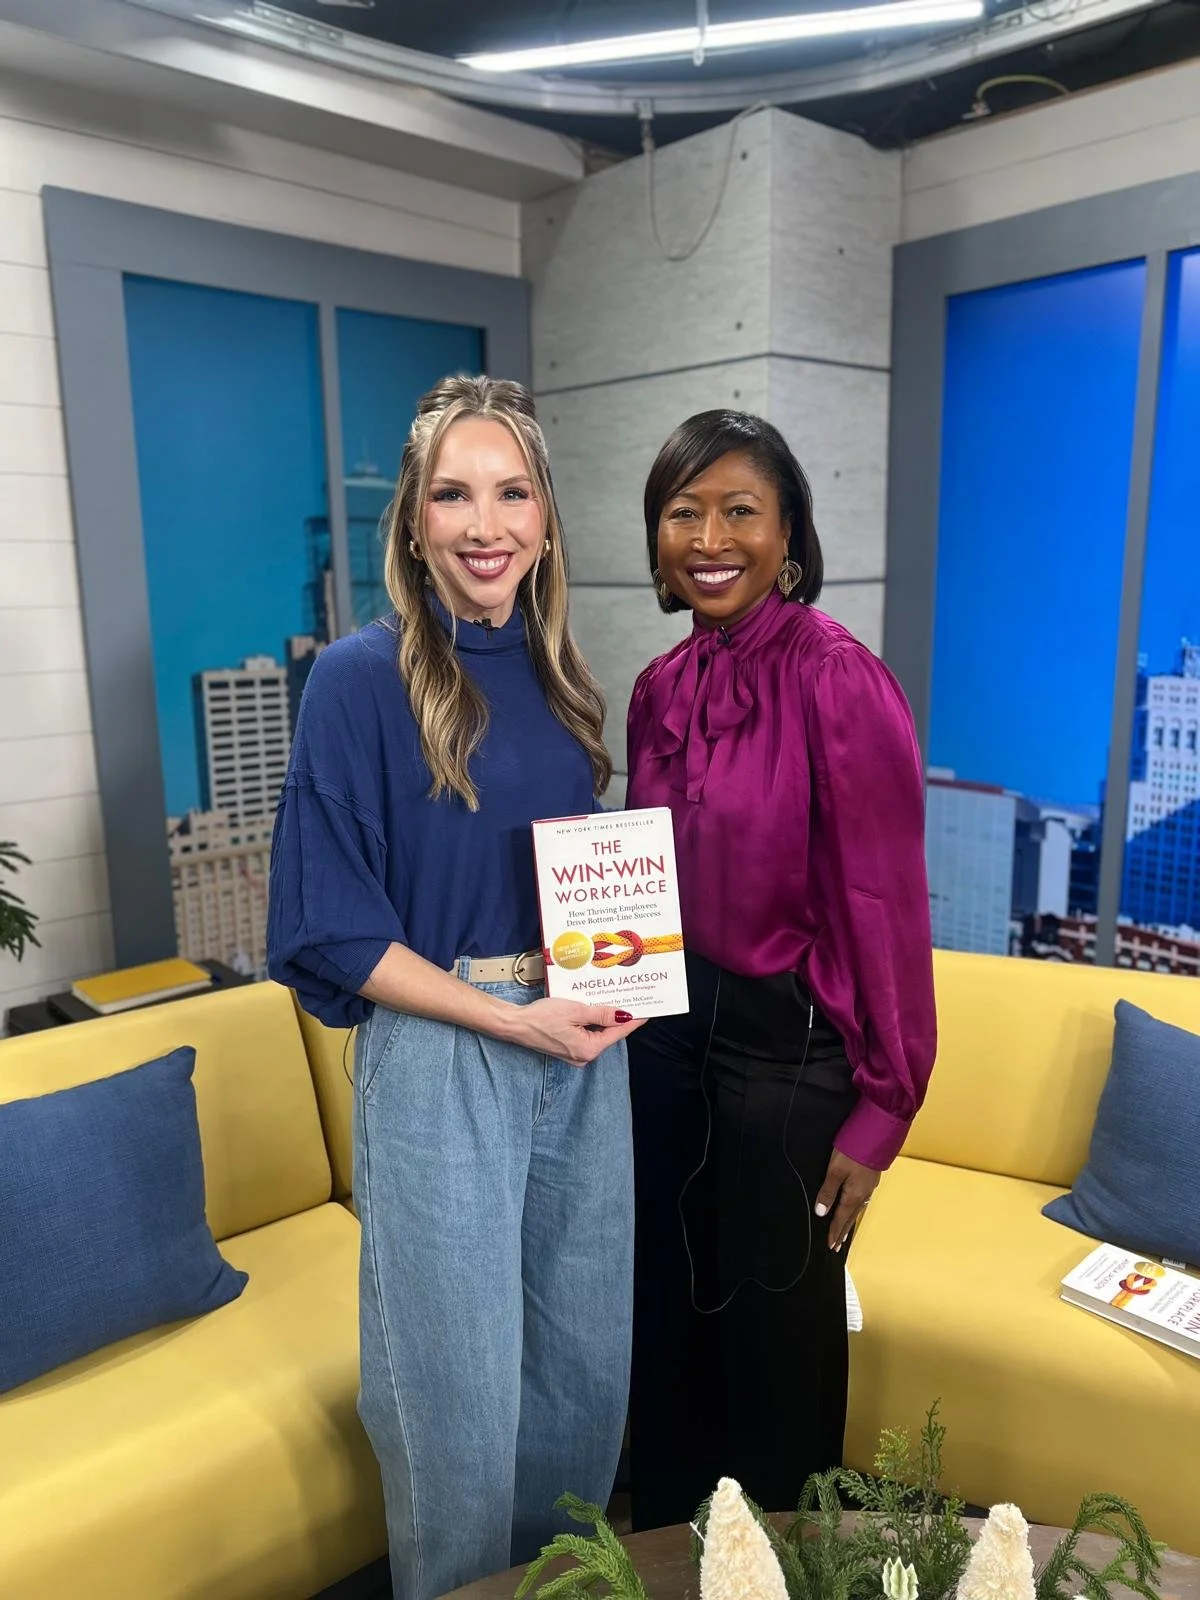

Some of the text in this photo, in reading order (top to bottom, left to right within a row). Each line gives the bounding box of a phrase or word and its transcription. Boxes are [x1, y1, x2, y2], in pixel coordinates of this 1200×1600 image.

[594, 823, 613, 831] TIMES
[615, 819, 654, 829] BESTSELLER
[591, 839, 622, 856] THE
[551, 855, 665, 886] WIN-WIN
[555, 879, 667, 905] WORKPLACE
[566, 911, 661, 927] Drive Bottom-Line Success
[568, 902, 658, 918] How Thriving Employees
[571, 971, 669, 991] ANGELA JACKSON
[1167, 1287, 1200, 1326] ORKPLACE
